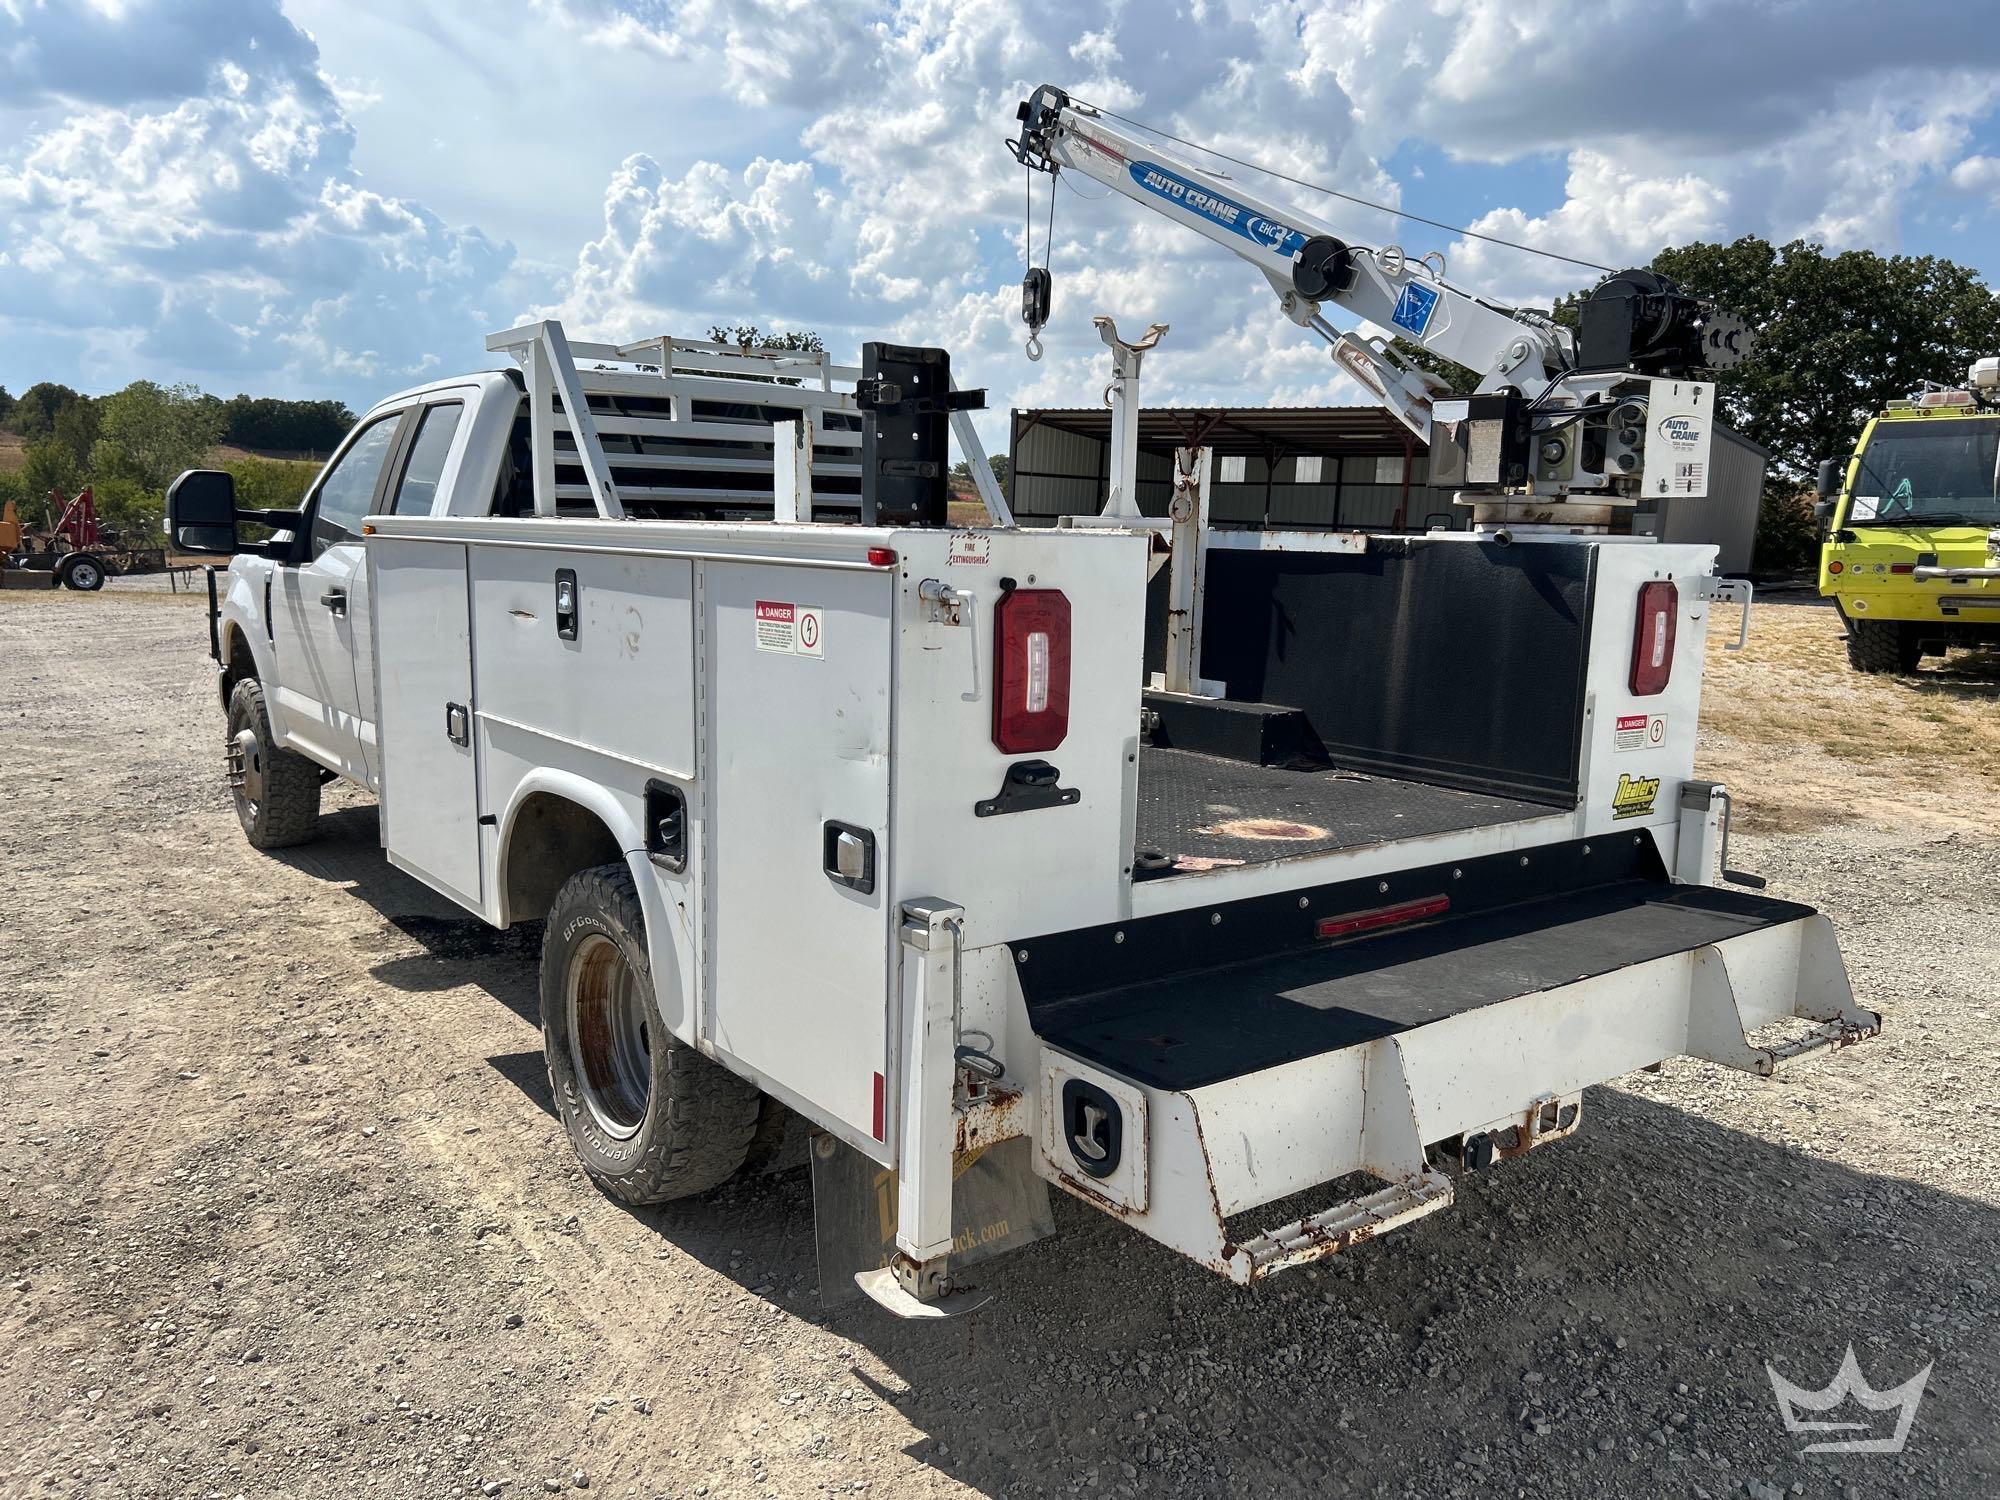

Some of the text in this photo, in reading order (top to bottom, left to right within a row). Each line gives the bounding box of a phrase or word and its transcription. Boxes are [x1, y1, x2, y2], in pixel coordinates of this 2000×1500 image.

[1143, 170, 1186, 199] AUTO
[1185, 189, 1240, 225] CRANE
[1665, 420, 1689, 431] AUTO
[1670, 430, 1700, 441] CRANE
[964, 543, 976, 551] FIRE
[952, 555, 986, 565] EXTINGUISHER
[765, 607, 792, 619] DANGER
[1624, 719, 1646, 728] DANGER
[1612, 773, 1660, 808] Dealers
